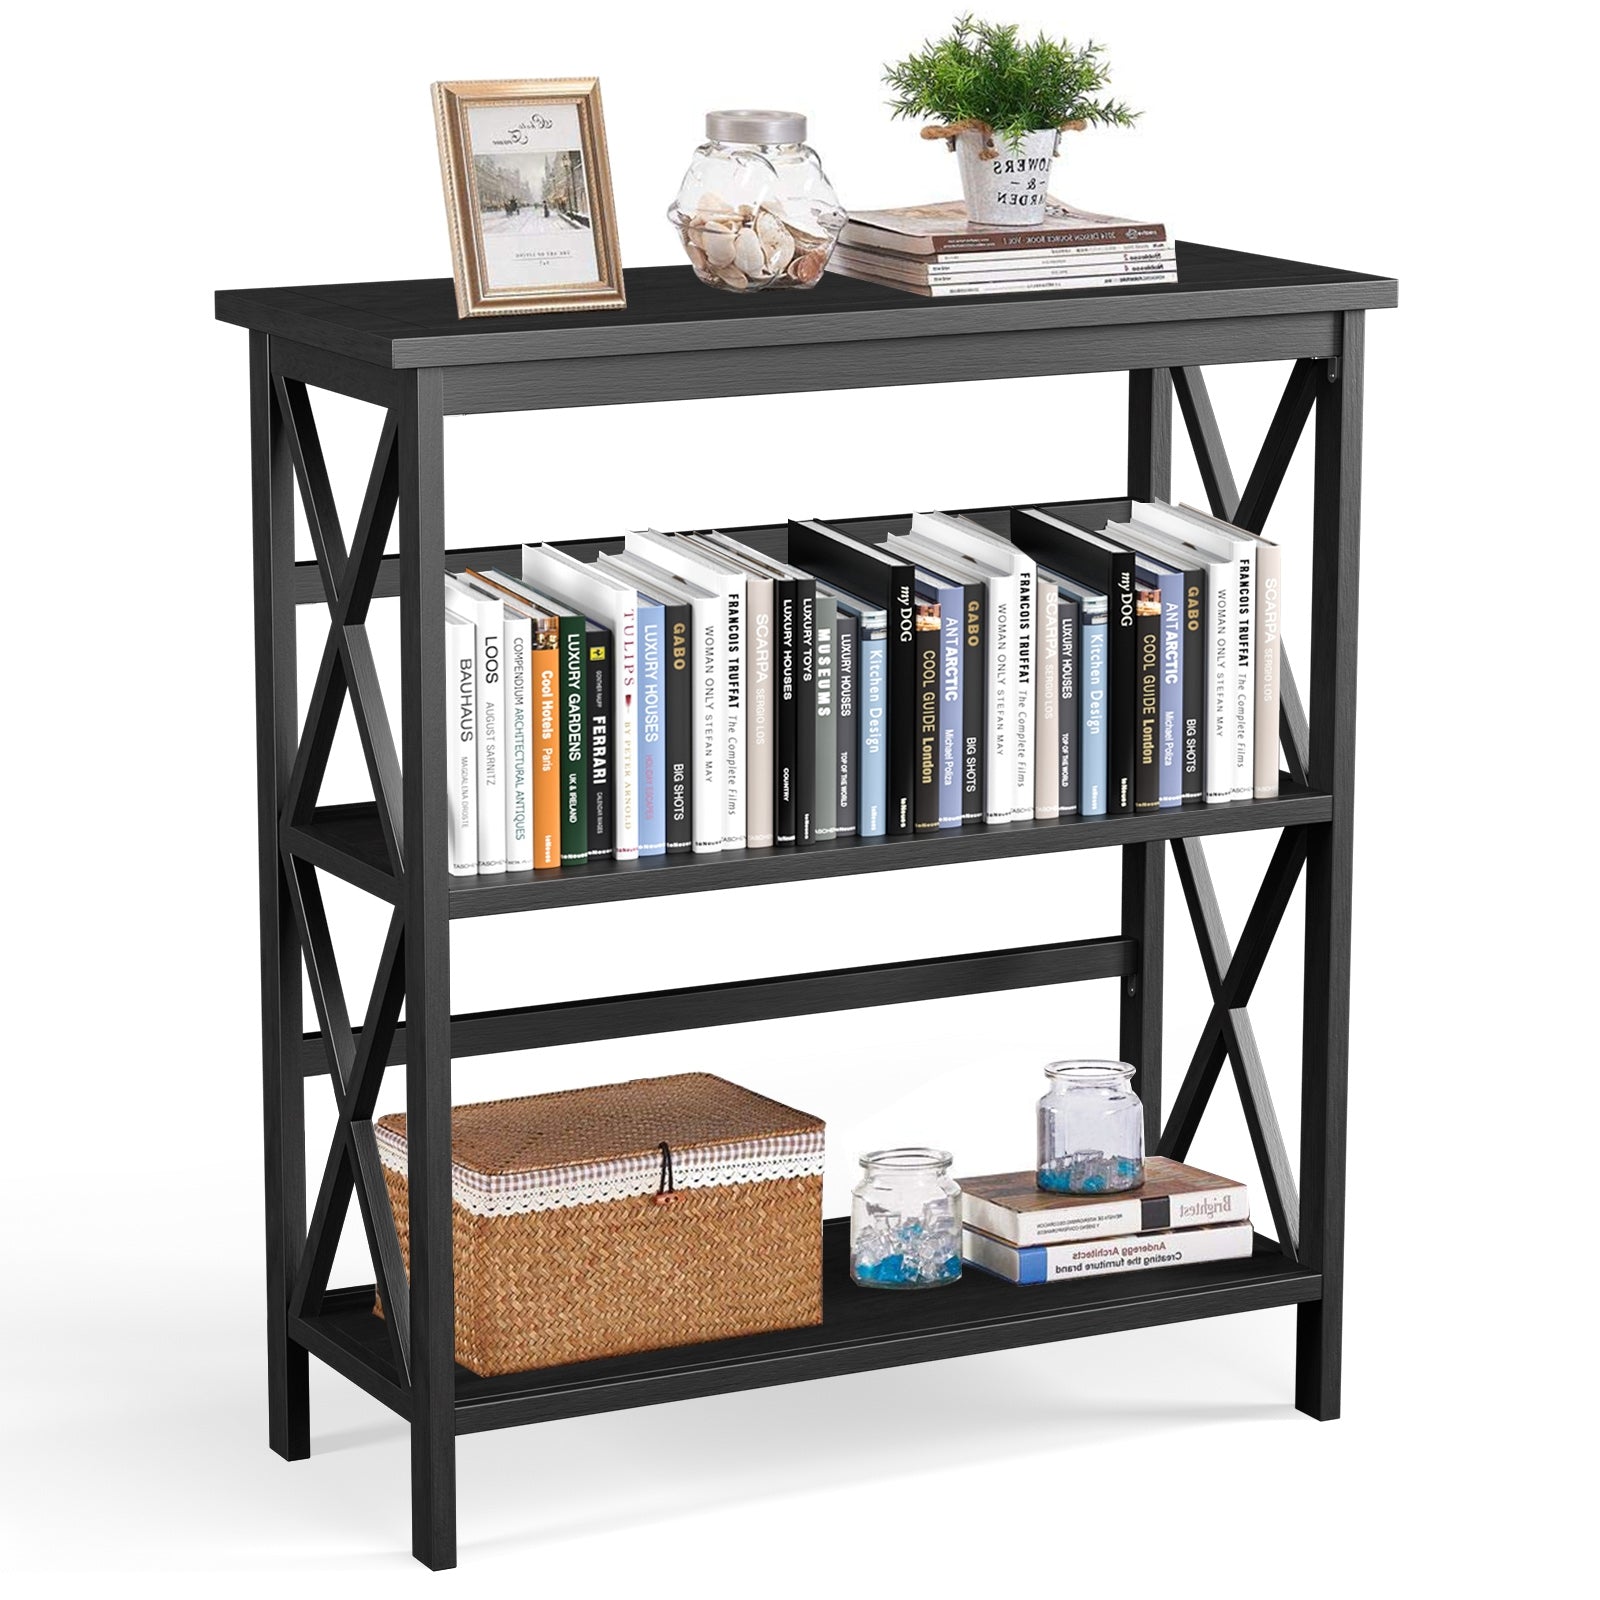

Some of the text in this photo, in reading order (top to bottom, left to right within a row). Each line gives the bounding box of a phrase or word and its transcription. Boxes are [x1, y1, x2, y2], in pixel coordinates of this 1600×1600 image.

[783, 599, 792, 647] LUXURY
[897, 585, 912, 642] my DOG
[967, 600, 980, 648] GABO
[1118, 572, 1133, 628] my DOG
[1187, 586, 1199, 632] GABO
[624, 609, 634, 687] TULIPS
[645, 624, 658, 681] LUXURY
[673, 622, 686, 671] GABO
[803, 598, 812, 682] LUXURY TOYS
[841, 634, 851, 672] LUXURY
[1045, 592, 1058, 720] SCARPA SERGIO LOS
[1062, 618, 1073, 656] LUXURY
[1216, 589, 1226, 737] WOMAN ONLY STEFAN MAY
[1236, 559, 1250, 768] FRANCOIS TRUFFAT The Complete Films
[1264, 578, 1277, 702] SCARPA SERGIO LOS
[460, 658, 473, 742] BAUHAUS
[568, 633, 580, 762] LUXURY GARDENS
[755, 613, 769, 745] SCARPA SERGIO LOS
[783, 650, 792, 701] HOUSES
[818, 628, 830, 717] MUSEUMS
[841, 675, 851, 717] HOUSES
[866, 650, 883, 753] Kitchen Design
[944, 617, 959, 786] ANTARCTIC Michael Poliza
[996, 603, 1007, 756] WOMAN ONLY STEFAN MAY
[1016, 573, 1030, 788] FRANCOIS TRUFFAT The Complete Films
[1062, 659, 1073, 700] HOUSES
[1087, 633, 1104, 735] Kitchen Design
[1142, 634, 1156, 764] COOL GUIDE London
[1164, 602, 1179, 767] ANTARCTIC Michael Poliza
[485, 636, 499, 786] LOOS AUGUST SARNITZ
[541, 670, 553, 771] Cool Hotels Paris
[625, 722, 631, 735] BY
[645, 684, 658, 742] HOUSES
[704, 625, 715, 783] WOMAN ONLY STEFAN MAY
[726, 594, 739, 816] FRANCOIS TRUFFAT The Complete Films
[922, 650, 935, 784] COOL GUIDE London
[514, 637, 524, 840] COMPENDIUM ARCHITECTURAL ANTIQUES
[593, 716, 606, 784] FERRARI
[840, 752, 848, 764] TOP
[966, 736, 976, 792] BIG SHOTS
[1061, 733, 1069, 745] TOP
[1061, 745, 1069, 754] OF
[1186, 719, 1196, 772] BIG SHOTS
[461, 756, 469, 799] MAGDALENA
[569, 773, 577, 787] UK
[674, 763, 684, 821] BIG SHOTS
[840, 764, 848, 773] OF
[840, 786, 848, 808] WORLD
[1061, 767, 1069, 788] WORLD
[569, 792, 577, 823] IRELAND
